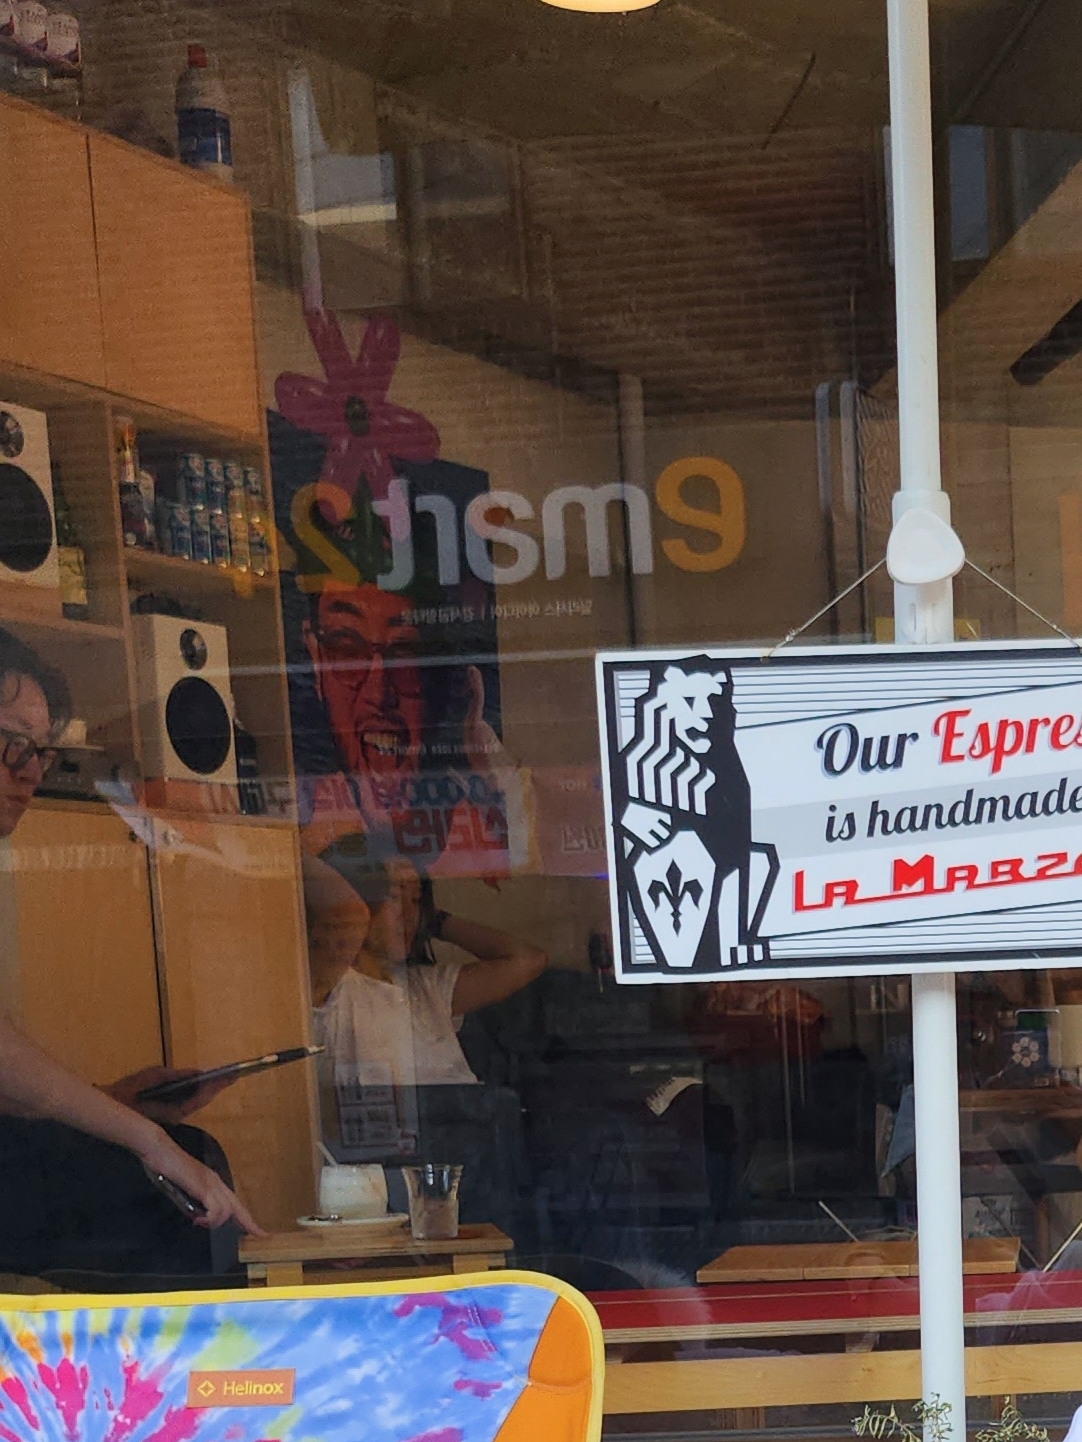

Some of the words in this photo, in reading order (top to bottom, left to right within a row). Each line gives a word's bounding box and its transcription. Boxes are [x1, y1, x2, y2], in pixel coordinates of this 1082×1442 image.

[817, 722, 919, 777] Our
[825, 804, 857, 843] is
[222, 1380, 284, 1396] Helinox
